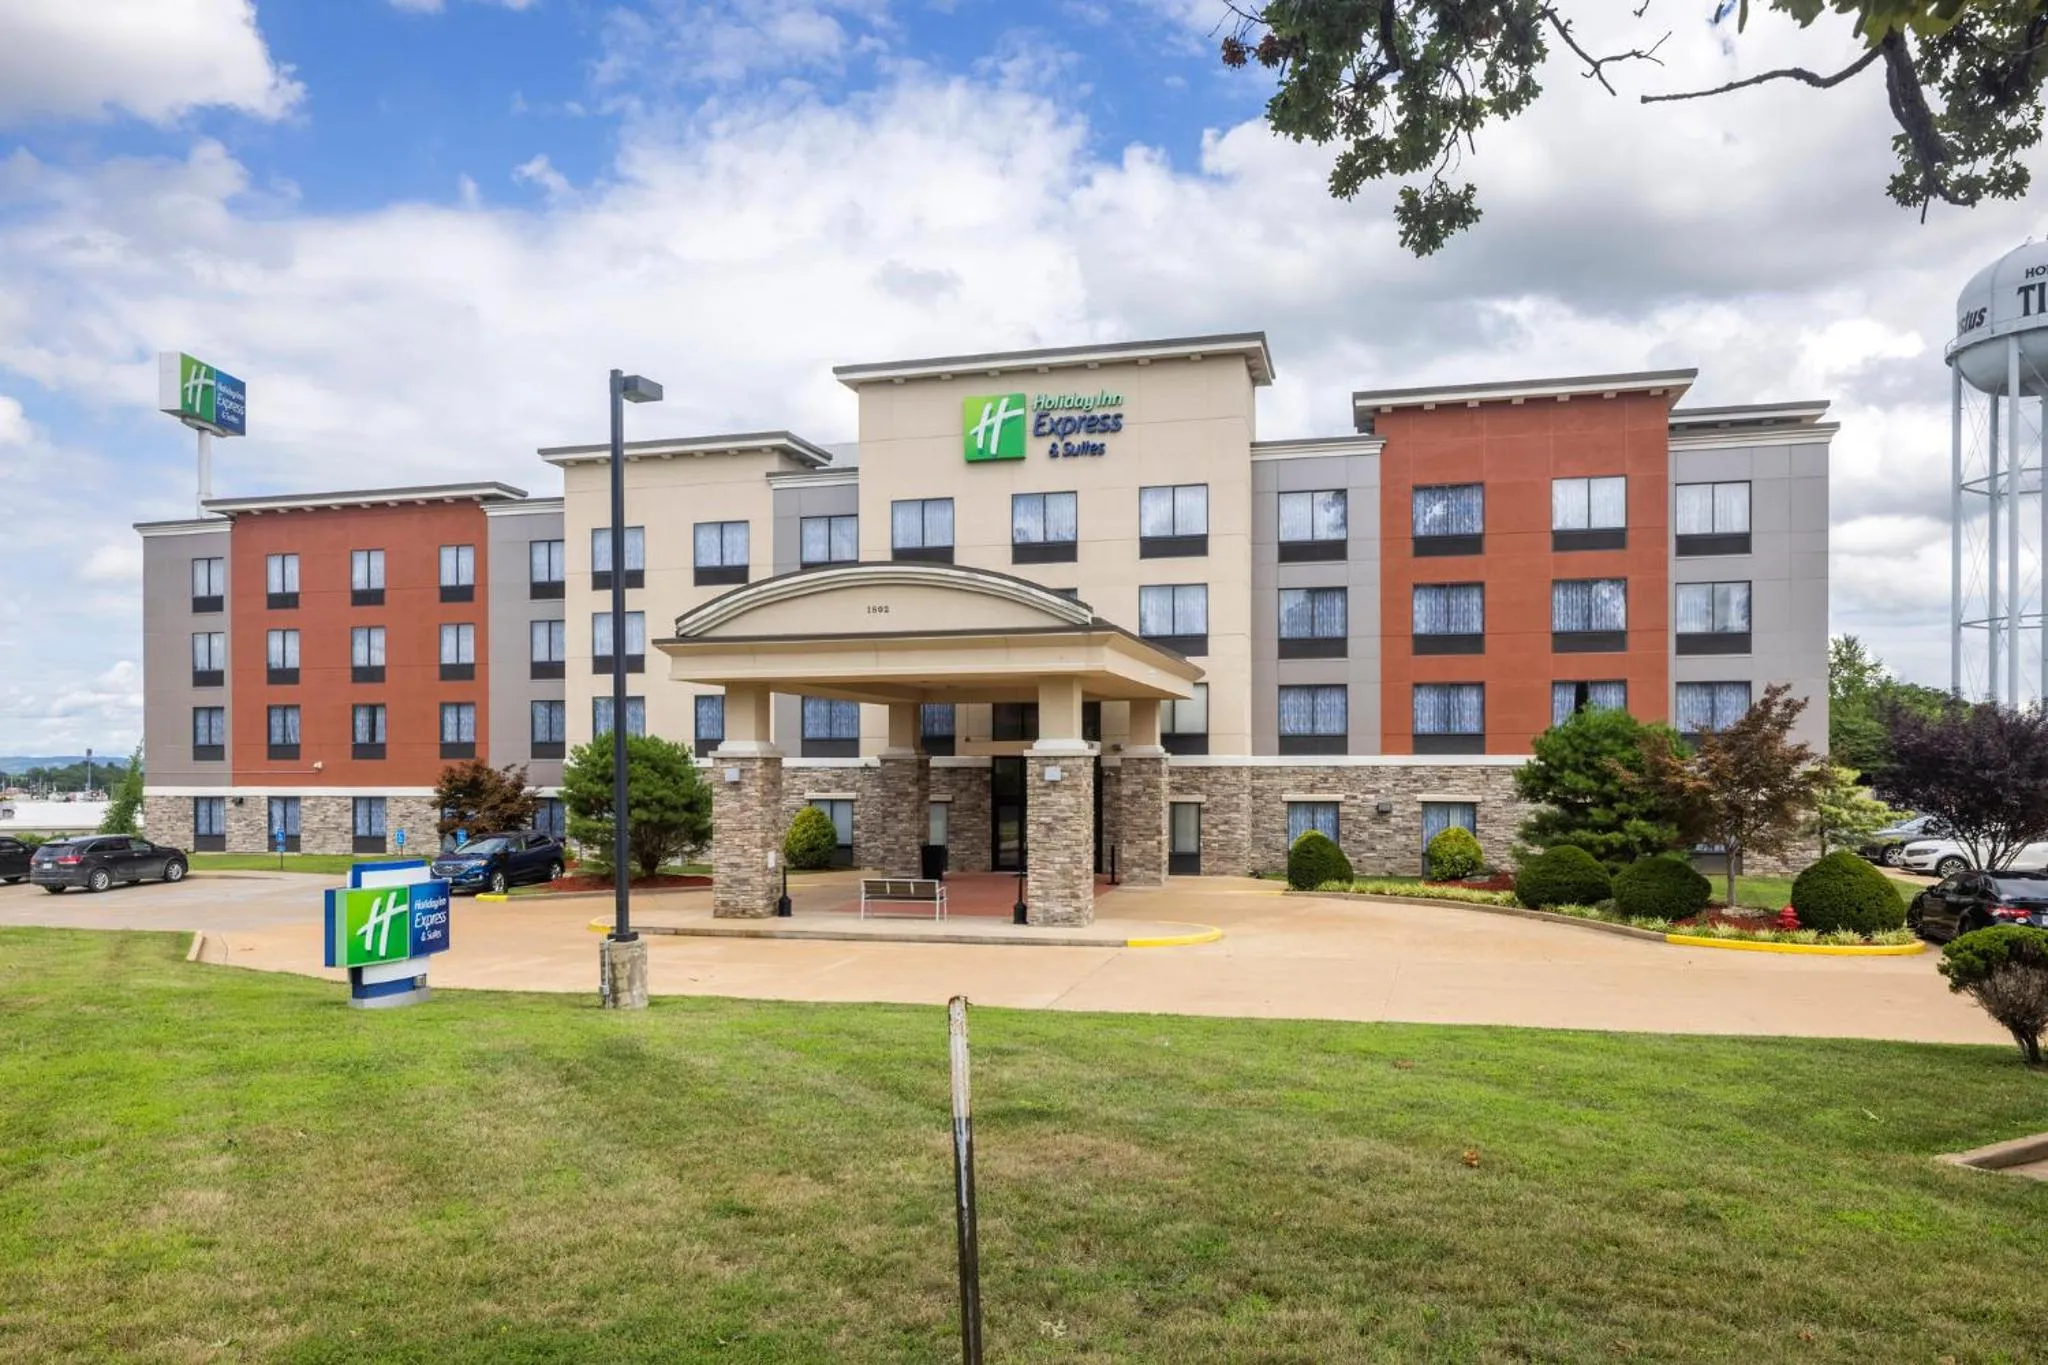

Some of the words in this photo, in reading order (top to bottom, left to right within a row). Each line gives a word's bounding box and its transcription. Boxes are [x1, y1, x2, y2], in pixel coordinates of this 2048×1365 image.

[1033, 393, 1095, 412] Holiday
[1097, 389, 1123, 408] Inn
[1033, 411, 1124, 442] Express
[1049, 442, 1059, 458] &
[1062, 441, 1106, 457] Suites
[415, 897, 438, 910] Holiday
[415, 911, 447, 931] Express
